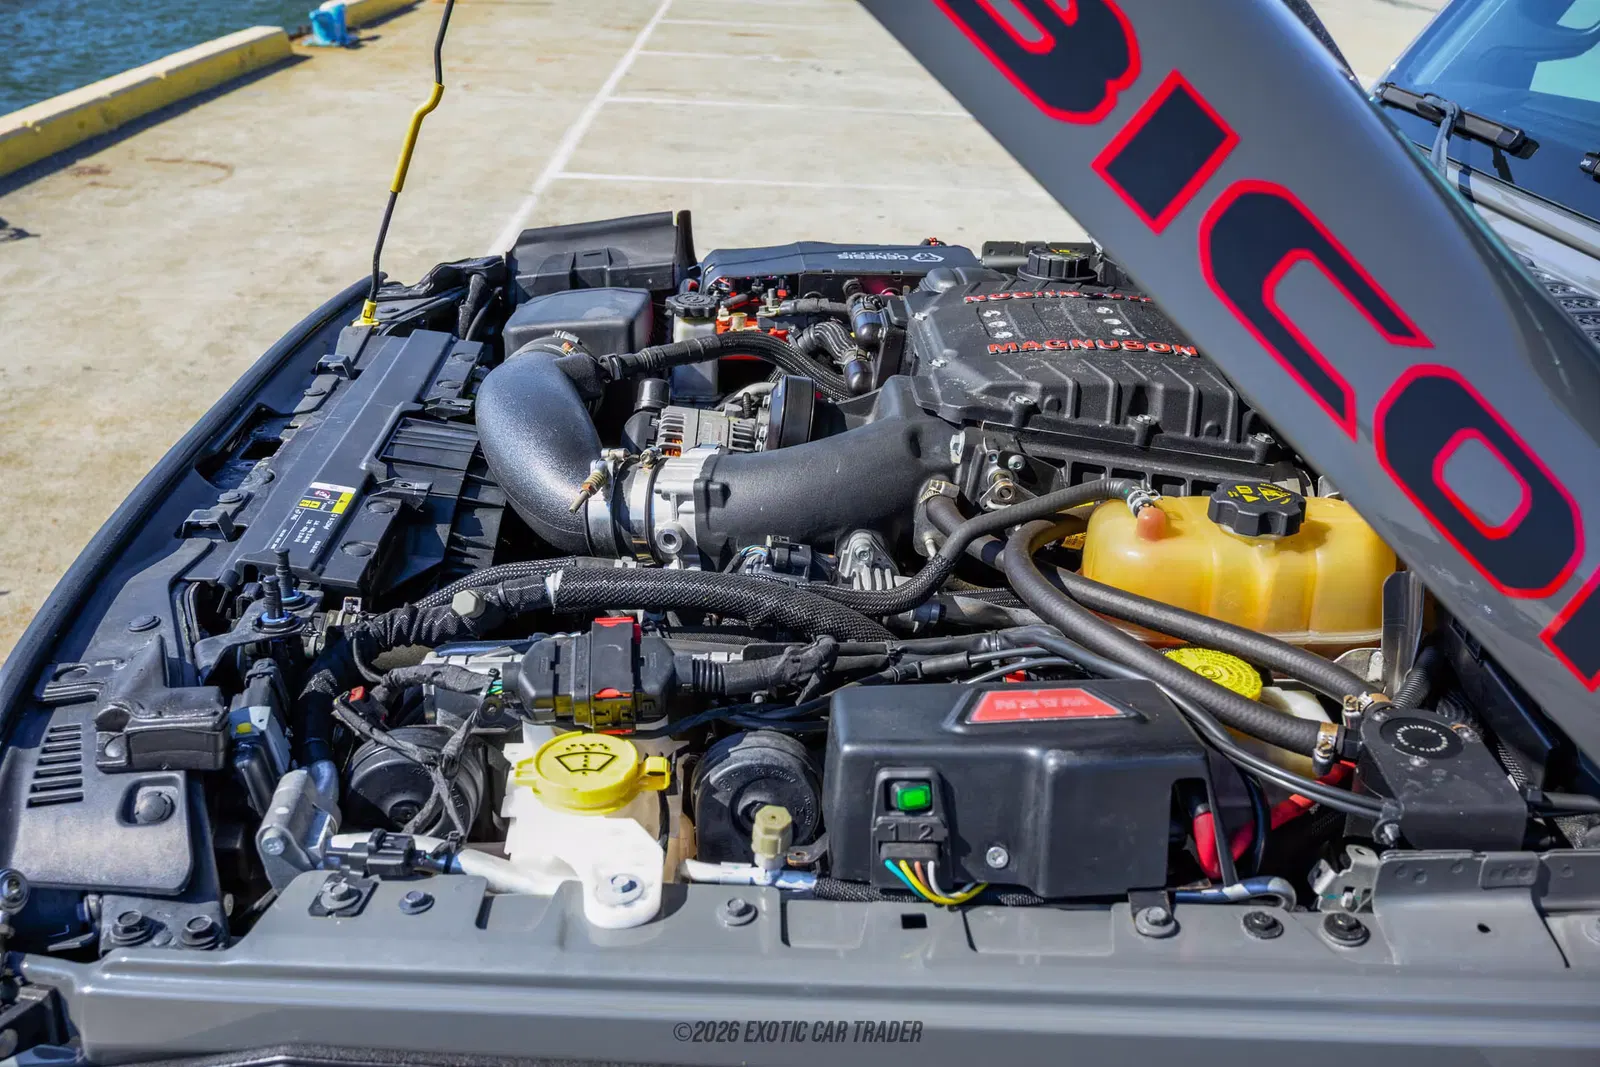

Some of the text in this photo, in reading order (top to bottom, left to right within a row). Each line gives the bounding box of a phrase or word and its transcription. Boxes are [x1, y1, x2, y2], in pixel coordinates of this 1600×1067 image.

[837, 253, 909, 261] GENESIS
[932, 0, 1600, 693] BICO
[986, 338, 1200, 358] MAGNUSON
[887, 822, 934, 841] 1 2
